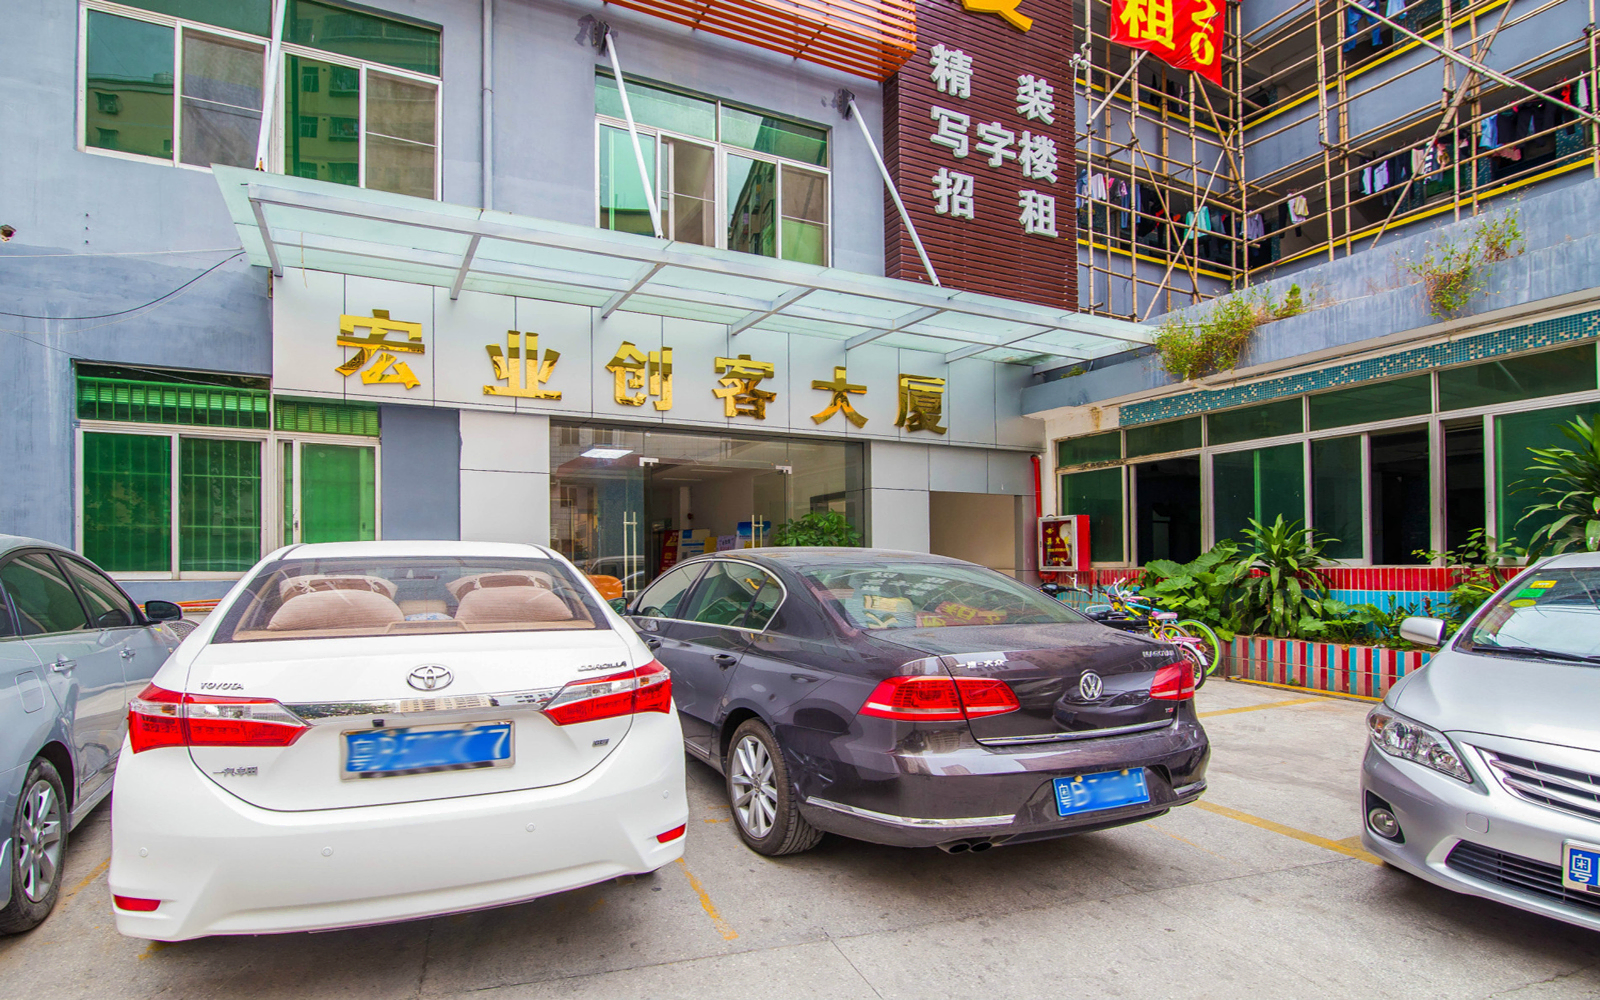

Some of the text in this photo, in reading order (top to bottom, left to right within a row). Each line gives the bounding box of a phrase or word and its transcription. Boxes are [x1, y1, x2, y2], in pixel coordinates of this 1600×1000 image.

[1119, 0, 1176, 51] 租
[930, 105, 1059, 184] 写字楼
[335, 309, 948, 435] 宏业创客大厦
[200, 682, 244, 691] TOYOTA
